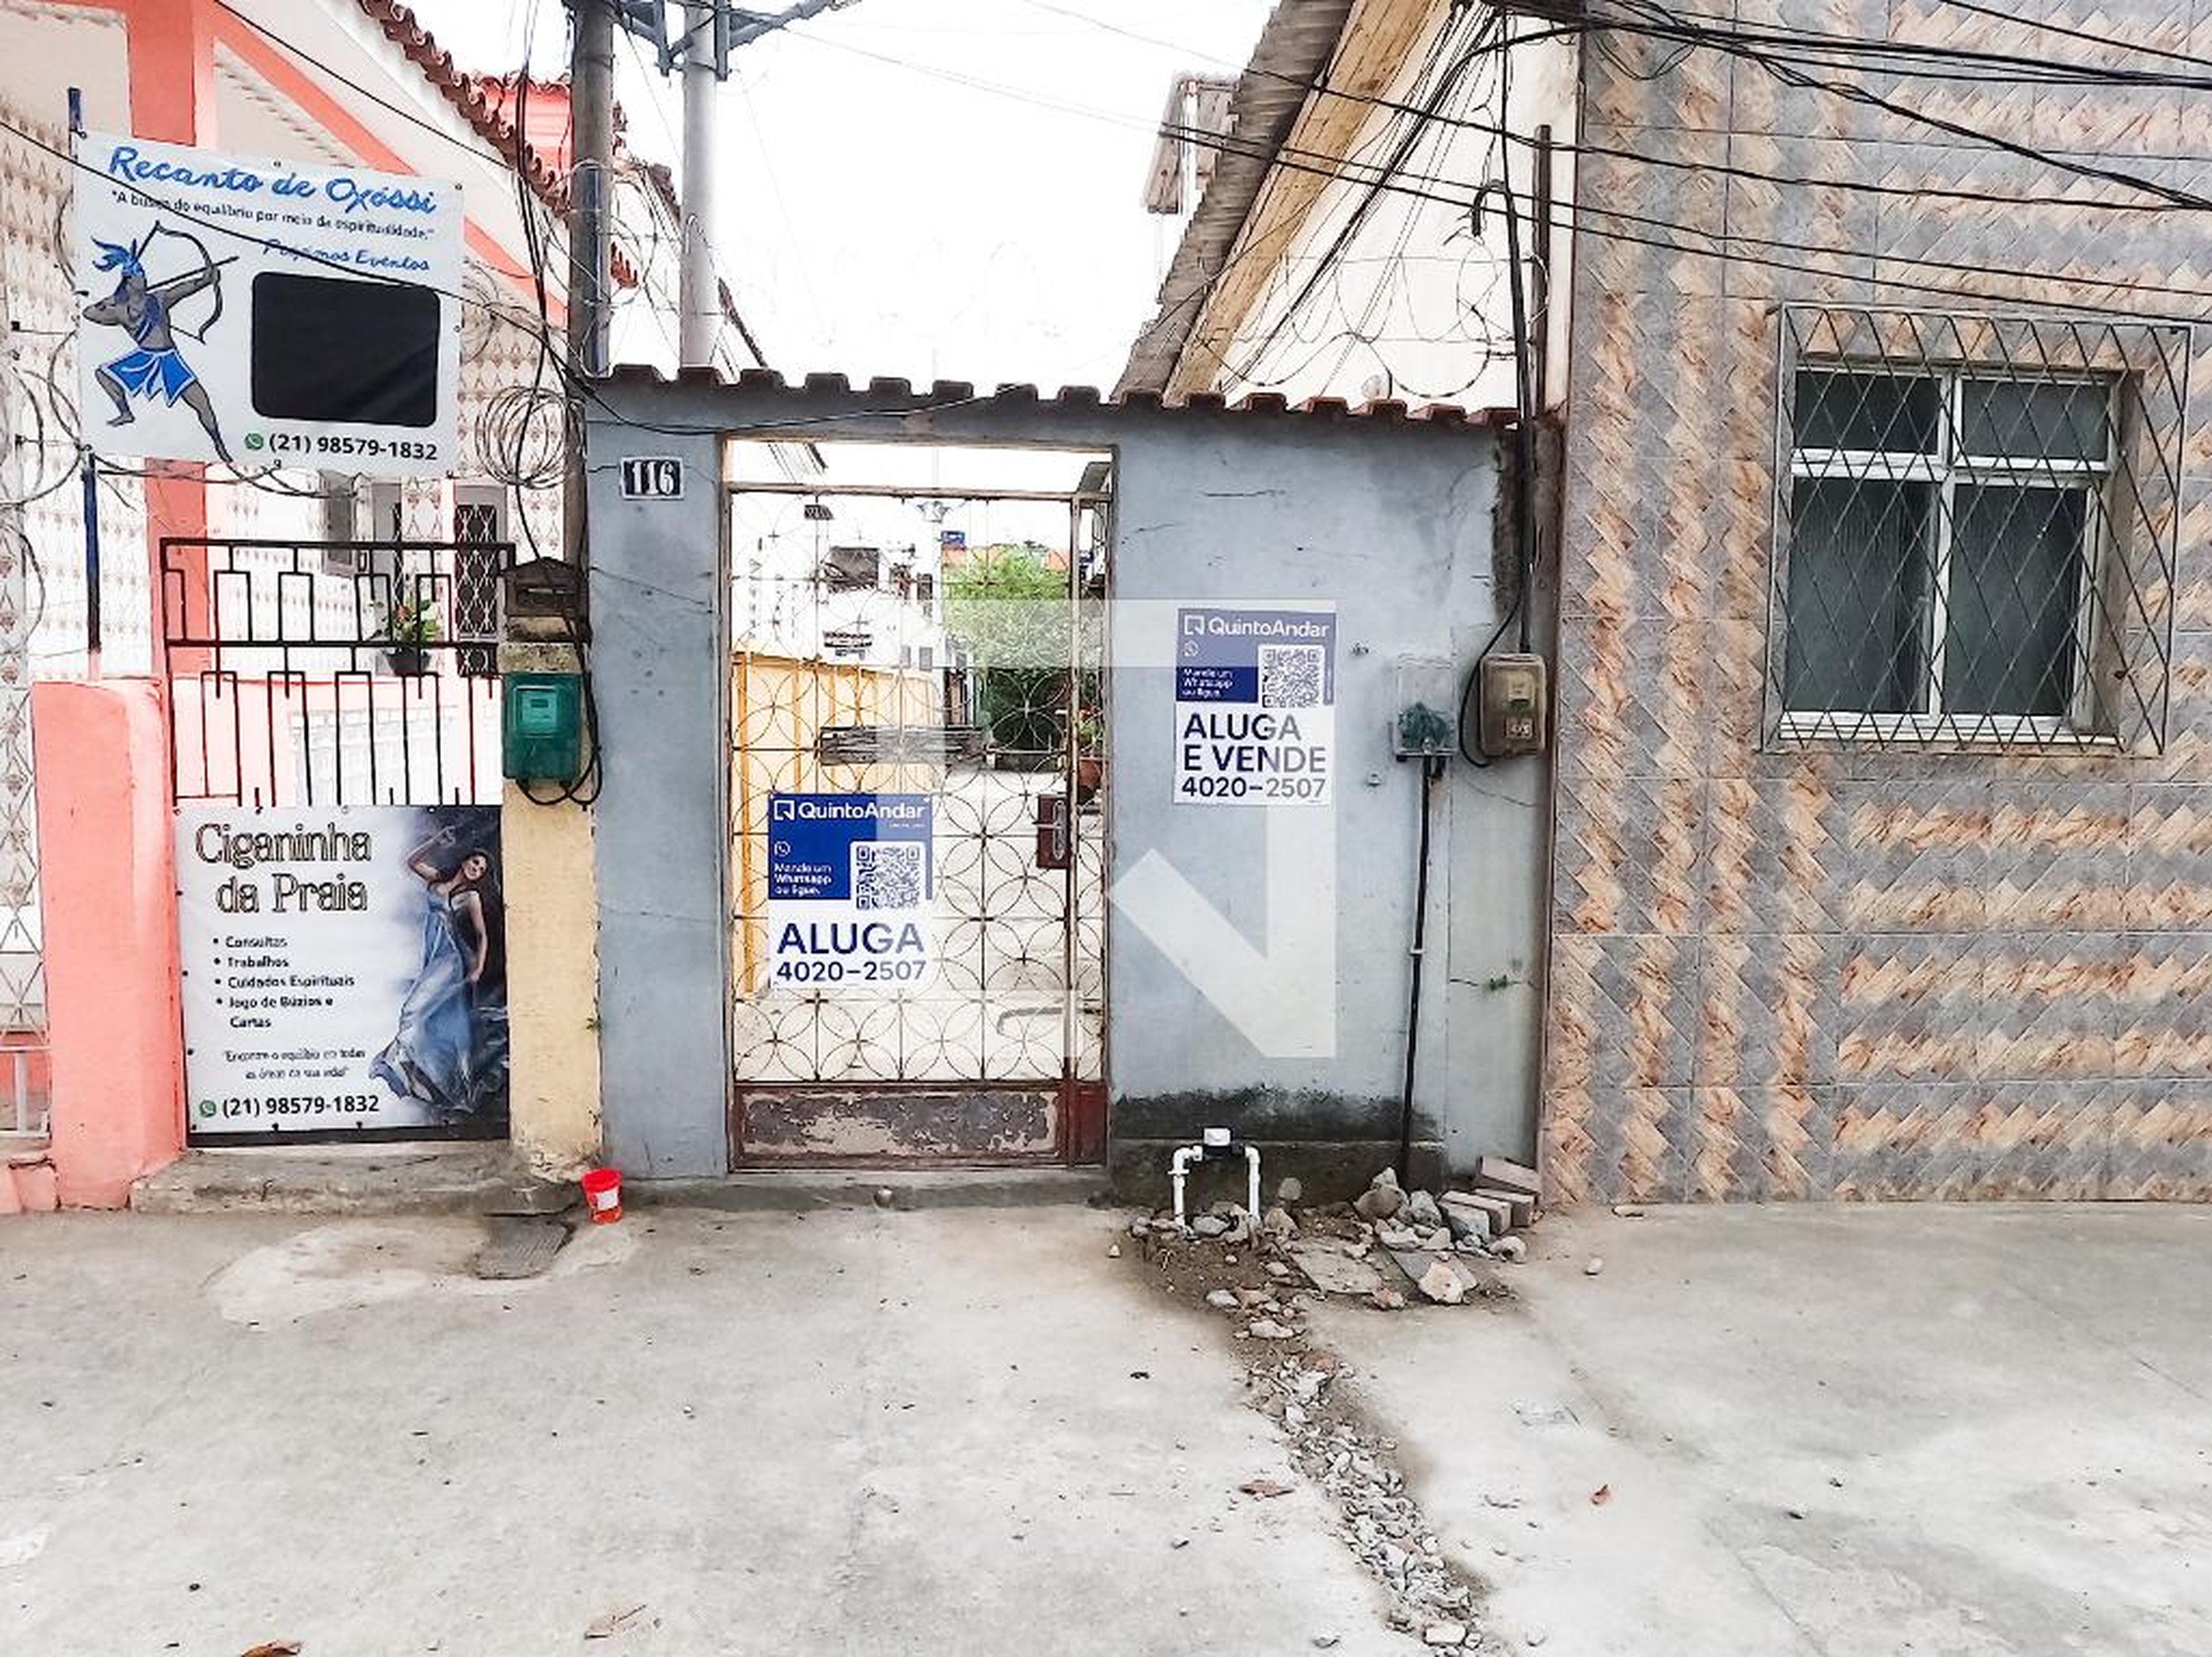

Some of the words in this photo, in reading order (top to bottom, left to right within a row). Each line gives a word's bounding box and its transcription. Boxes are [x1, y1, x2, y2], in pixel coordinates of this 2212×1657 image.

[109, 146, 263, 192] Recanto
[272, 172, 316, 197] de
[256, 212, 278, 223] por
[282, 214, 312, 225] meio
[355, 249, 430, 271] Eventos
[269, 433, 311, 453] (21)
[317, 437, 438, 460] 98579-1832
[632, 461, 673, 495] 116
[1209, 616, 1330, 638] QuintoAndar
[1183, 713, 1302, 741] ALUGA
[1184, 745, 1202, 771] E
[1211, 745, 1327, 773] VENDE
[1181, 776, 1327, 797] 4020-2507
[798, 802, 925, 819] QuintoAndar
[196, 822, 372, 869] Ciganinha
[774, 863, 812, 873] Mande
[813, 864, 832, 873] um
[215, 875, 260, 913] da
[272, 873, 368, 912] Praia
[225, 936, 288, 948] Consultas
[777, 923, 925, 954] ALUGA
[228, 955, 289, 968] Trabalhos
[777, 961, 927, 982] 4020-2507
[228, 976, 287, 988] Cuidados
[290, 975, 355, 988] Espirituais
[230, 996, 257, 1009] Jogo
[261, 996, 276, 1008] de
[280, 995, 322, 1006] Búzios
[325, 998, 334, 1006] e
[230, 1016, 272, 1028] Cartas
[222, 1097, 260, 1119] (21)
[266, 1095, 380, 1115] 98579-1832
